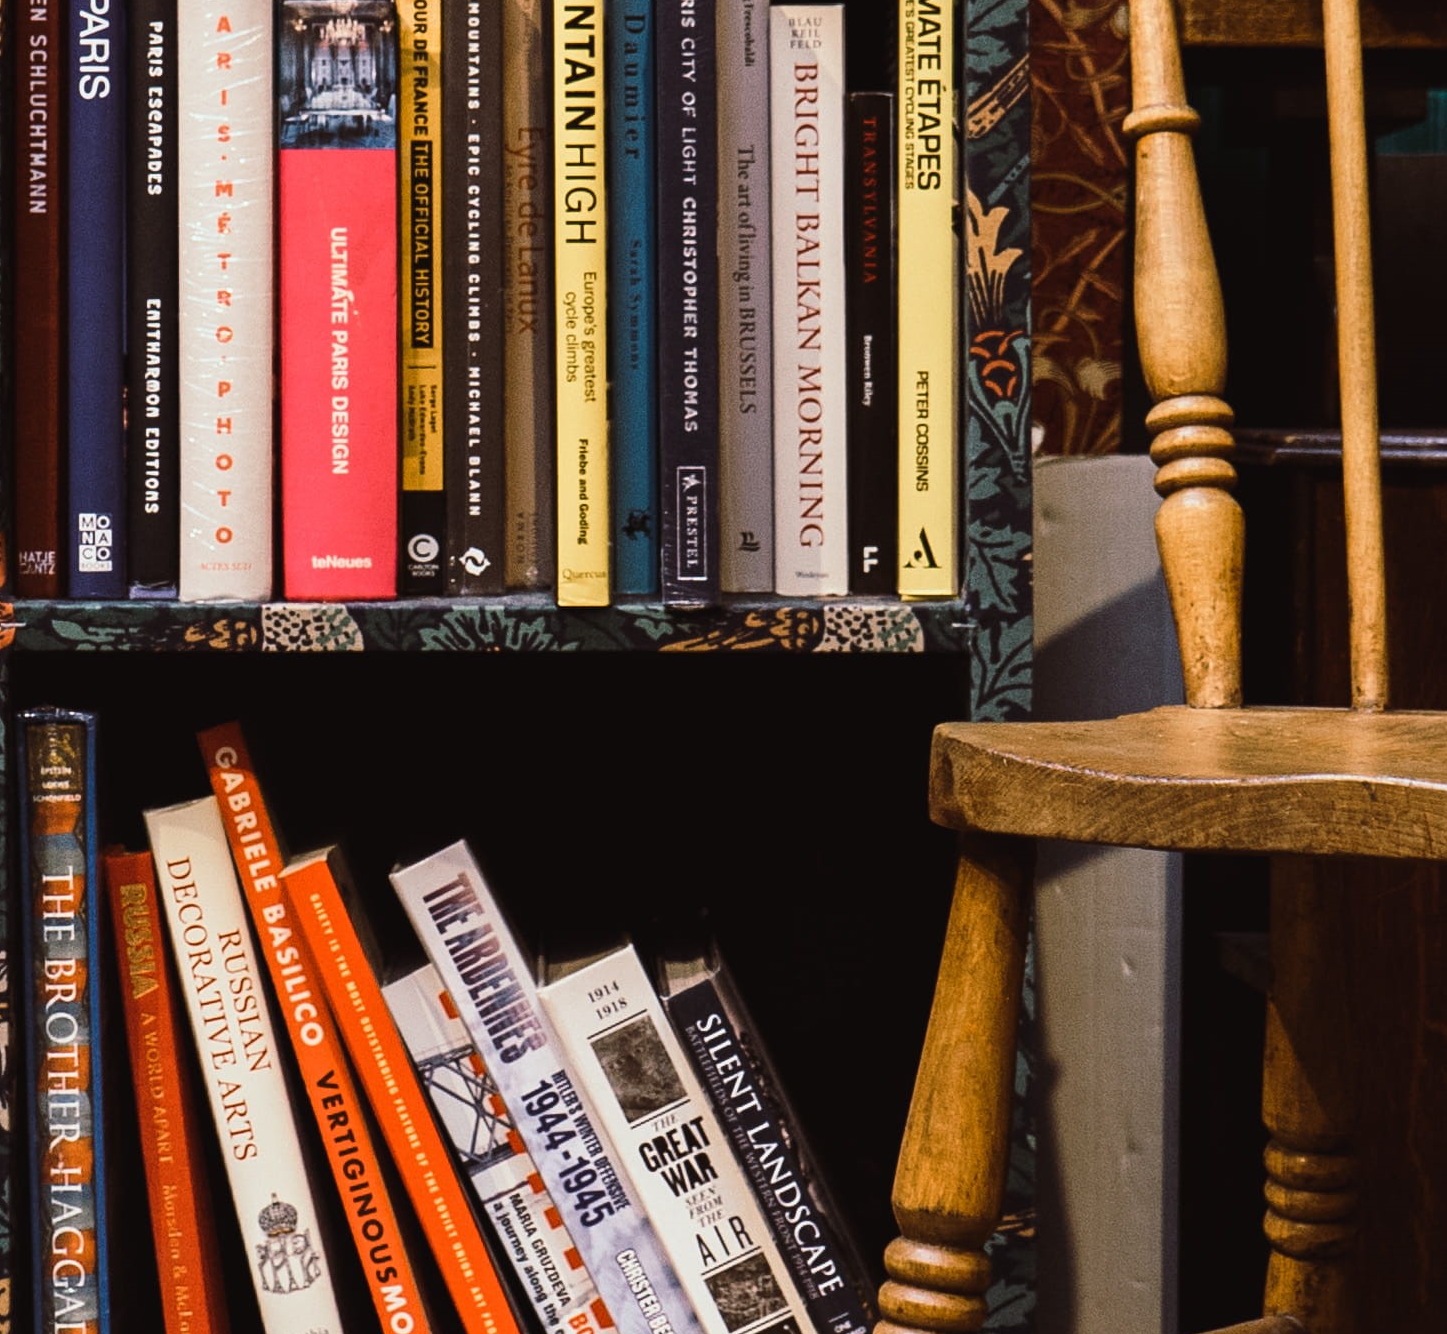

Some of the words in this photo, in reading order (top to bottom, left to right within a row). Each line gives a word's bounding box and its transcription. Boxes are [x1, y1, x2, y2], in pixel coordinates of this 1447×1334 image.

[413, 38, 427, 61] DE
[467, 2, 481, 109] MOUNTAINS
[680, 37, 695, 82] CITY
[25, 34, 48, 213] SCHLUCHTMANN
[413, 65, 427, 136] FRANCE
[680, 92, 696, 118] OF
[794, 63, 819, 200] BRIGHT
[917, 79, 946, 189] ÉTAPES
[413, 142, 428, 177] THE
[467, 133, 480, 175] EPIC
[681, 127, 696, 186] LIGHT
[413, 182, 429, 262] OFFICIAL
[467, 184, 482, 265] CYCLING
[564, 143, 597, 243] HIGH
[861, 116, 876, 283] TRANSYLVANIA
[330, 227, 347, 323] ULTIMATE
[414, 268, 429, 344] HISTORY
[581, 271, 597, 335] Europe's
[681, 197, 696, 339] CHRISTOPHER
[796, 213, 820, 350] BALKAN
[467, 273, 483, 342] CLIMBS
[561, 291, 578, 329] cycle
[331, 331, 347, 390] PARIS
[565, 334, 579, 383] climbs
[580, 340, 597, 402] greatest
[682, 348, 697, 434] THOMAS
[916, 370, 929, 419] PETER
[331, 396, 348, 475] DESIGN
[467, 366, 481, 447] MICHAEL
[468, 455, 481, 516] BLANN
[797, 364, 822, 548] MORNING
[915, 423, 928, 491] COSSINS
[685, 495, 698, 568] PRESTEL
[41, 866, 75, 941] THE
[212, 742, 278, 893] GABRIELE
[261, 901, 326, 1049] BASILICO
[419, 871, 485, 935] THE
[166, 857, 236, 1070] DECORATIVE
[217, 1080, 257, 1160] ARTS
[217, 928, 271, 1071] RUSSIAN
[444, 919, 549, 1067] ARDENNES
[45, 957, 81, 1153] BROTHER
[515, 1073, 617, 1233] 1944-1945
[695, 1013, 762, 1113] SILENT
[746, 1120, 844, 1296] LANDSCAPE
[492, 1200, 503, 1212] a
[493, 1210, 530, 1263] journey
[508, 1191, 538, 1237] MARIA
[530, 1236, 571, 1307] GRUZDEVA
[520, 1263, 550, 1303] along
[541, 1302, 561, 1326] the
